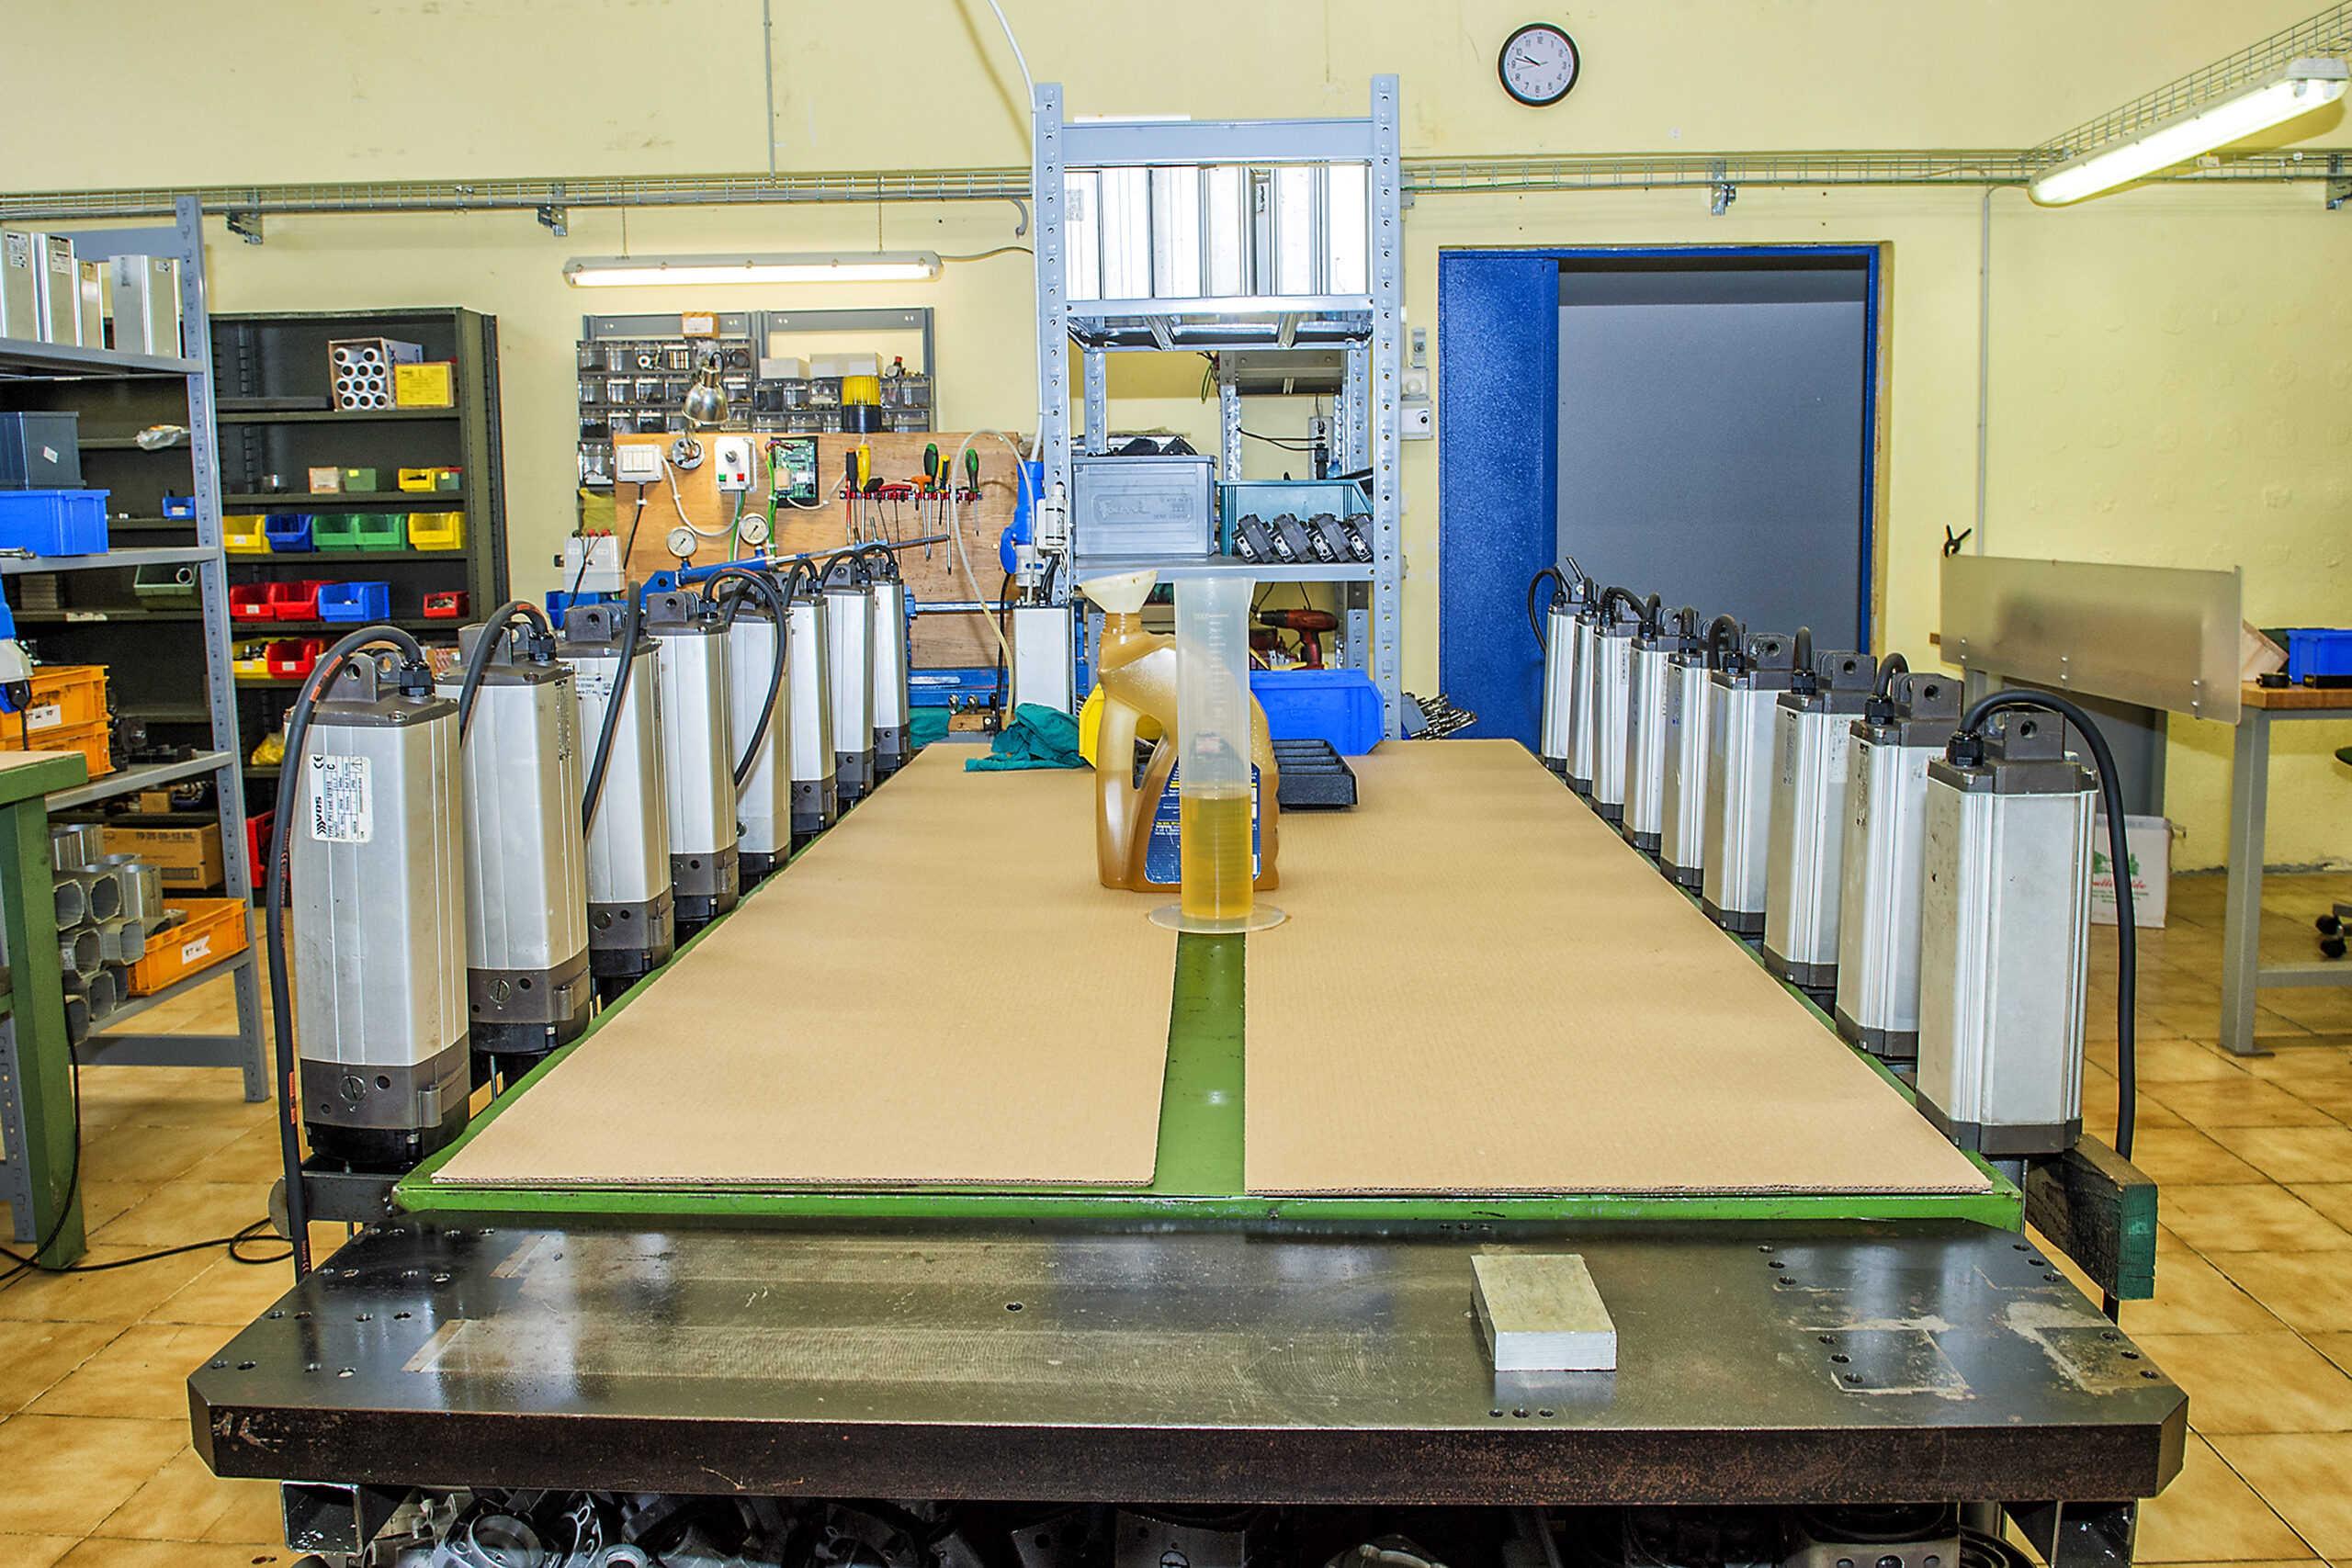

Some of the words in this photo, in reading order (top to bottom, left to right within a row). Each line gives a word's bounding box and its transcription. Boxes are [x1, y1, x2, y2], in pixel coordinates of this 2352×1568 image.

[1537, 36, 1544, 44] 12
[1516, 48, 1522, 56] 10
[1511, 61, 1516, 69] 9
[1524, 82, 1529, 90] 7
[313, 755, 324, 770] CE
